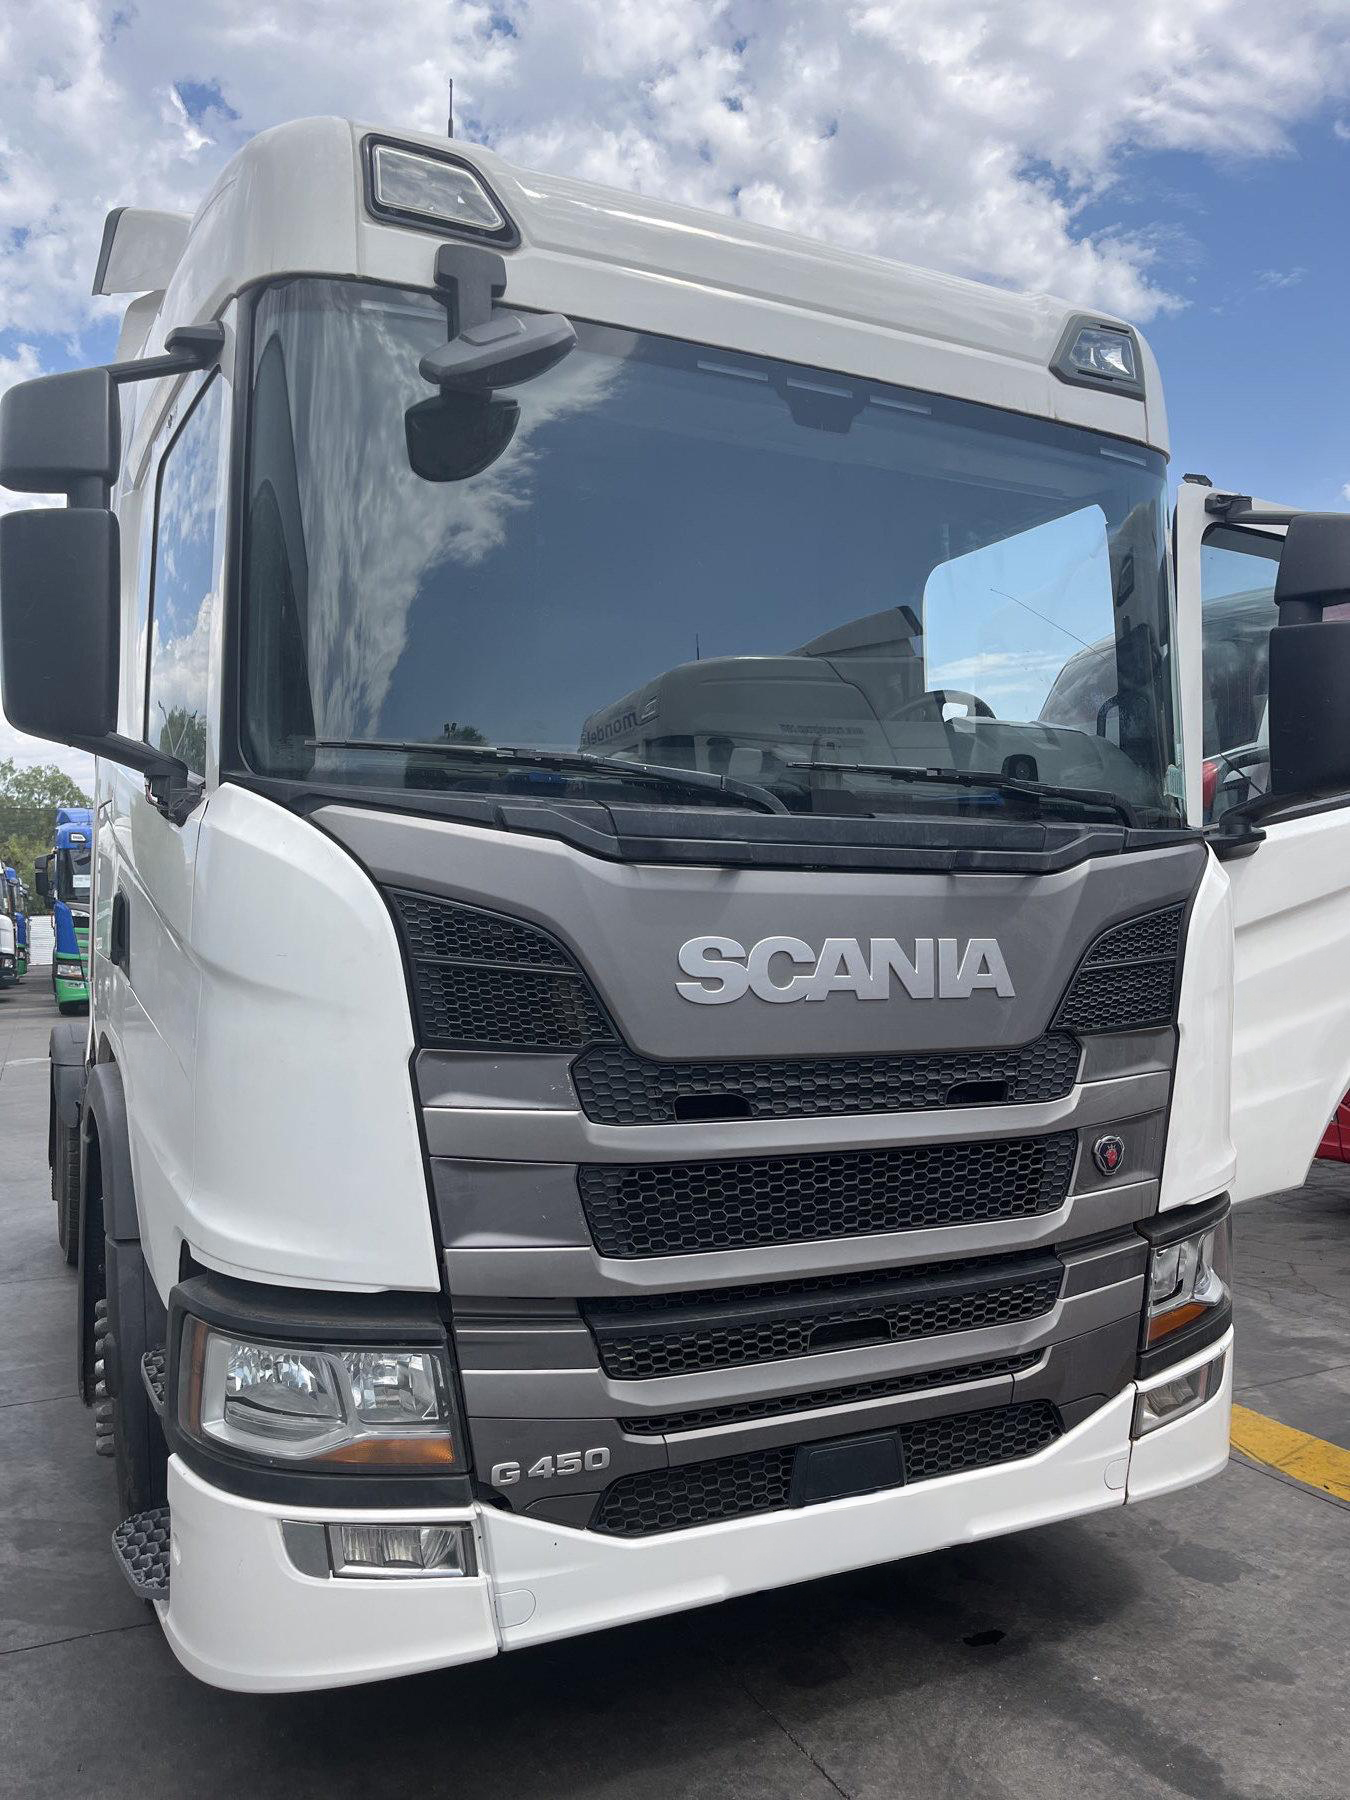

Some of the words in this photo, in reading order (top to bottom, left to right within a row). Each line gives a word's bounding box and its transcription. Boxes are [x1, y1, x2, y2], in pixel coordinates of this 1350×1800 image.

[675, 935, 1016, 1006] SCANIA
[491, 1461, 521, 1487] G
[527, 1447, 611, 1479] 450
